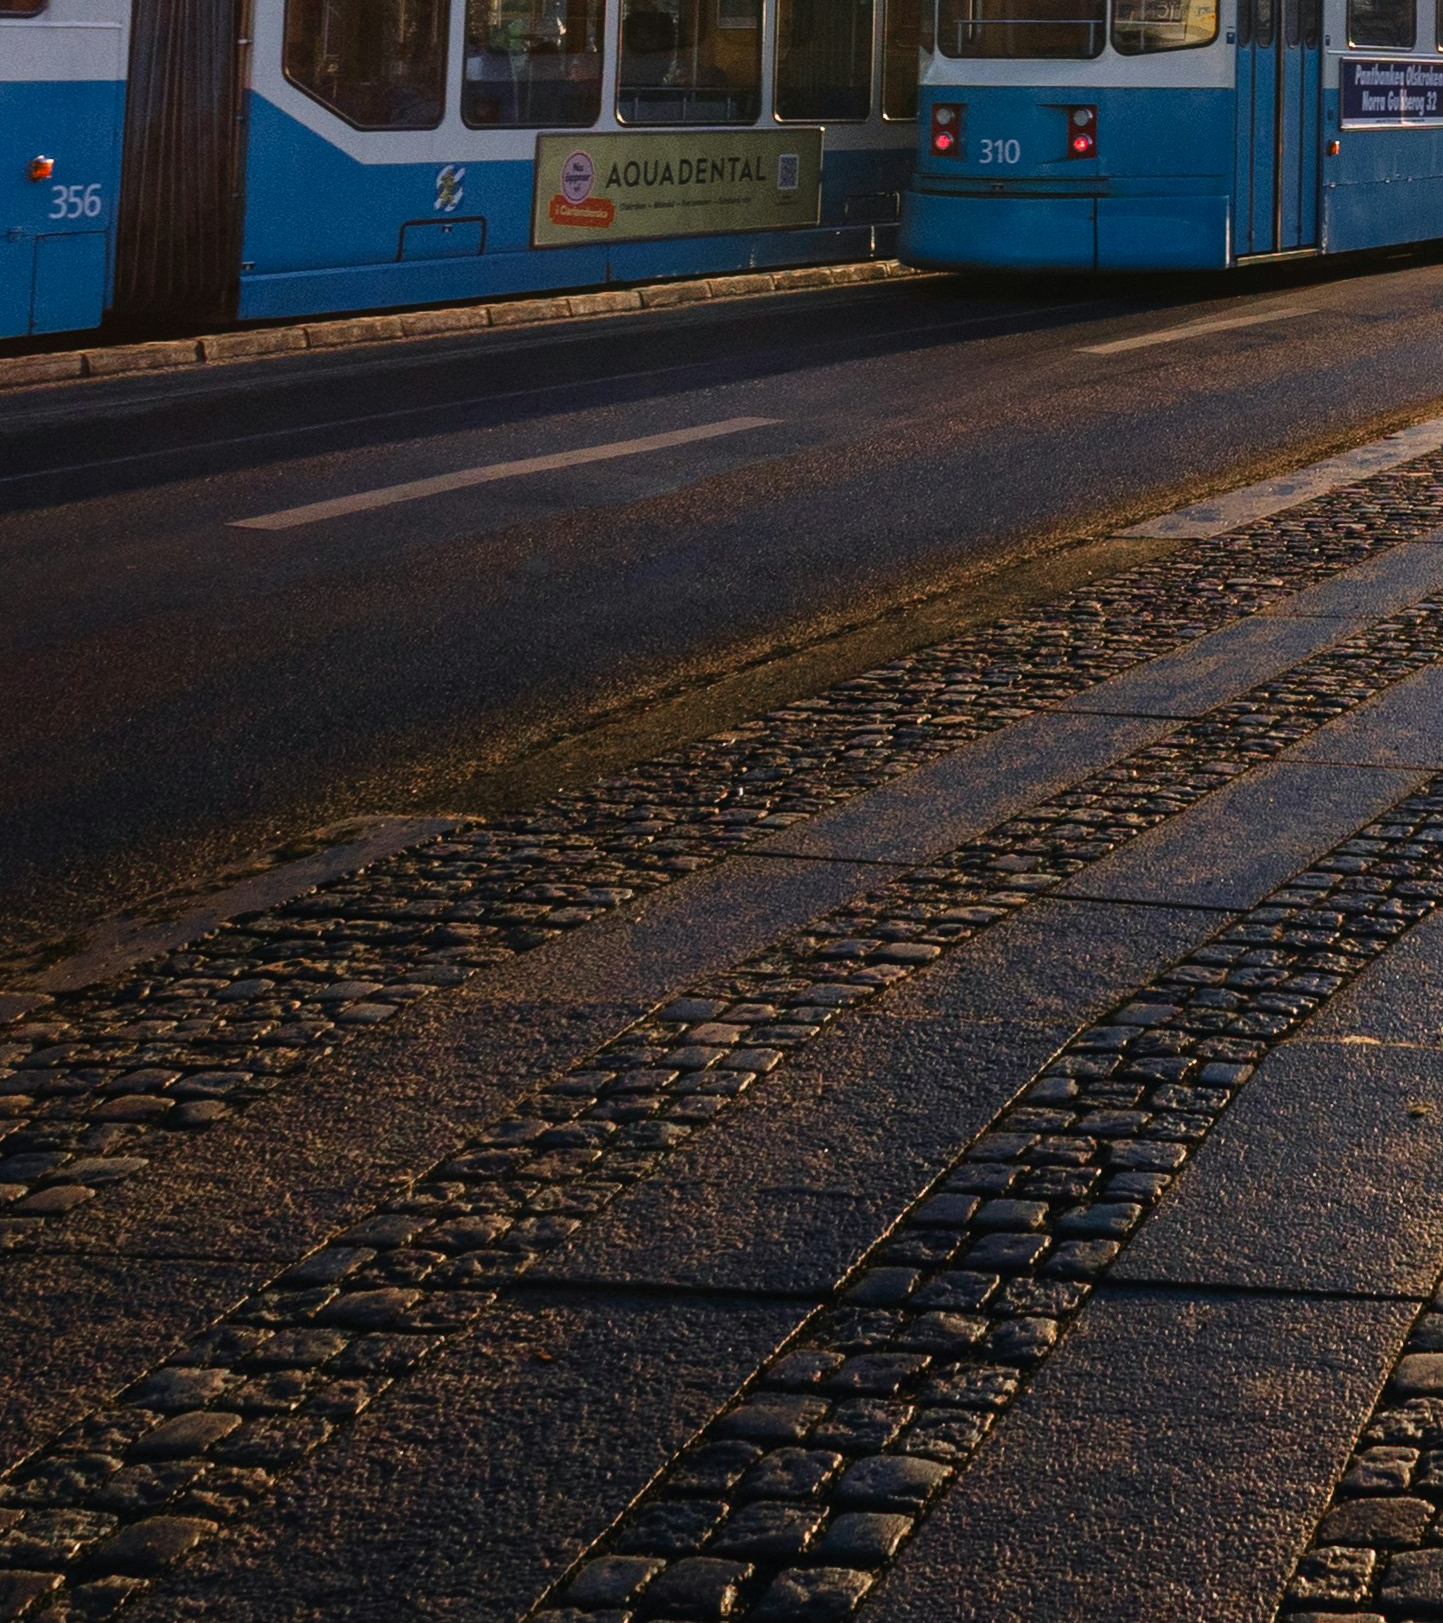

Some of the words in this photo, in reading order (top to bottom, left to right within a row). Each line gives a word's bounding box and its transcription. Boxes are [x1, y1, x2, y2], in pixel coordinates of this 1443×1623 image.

[1361, 90, 1386, 111] Norra
[979, 139, 1021, 164] 310
[605, 156, 767, 189] AQUADENTAL
[48, 183, 102, 219] 356
